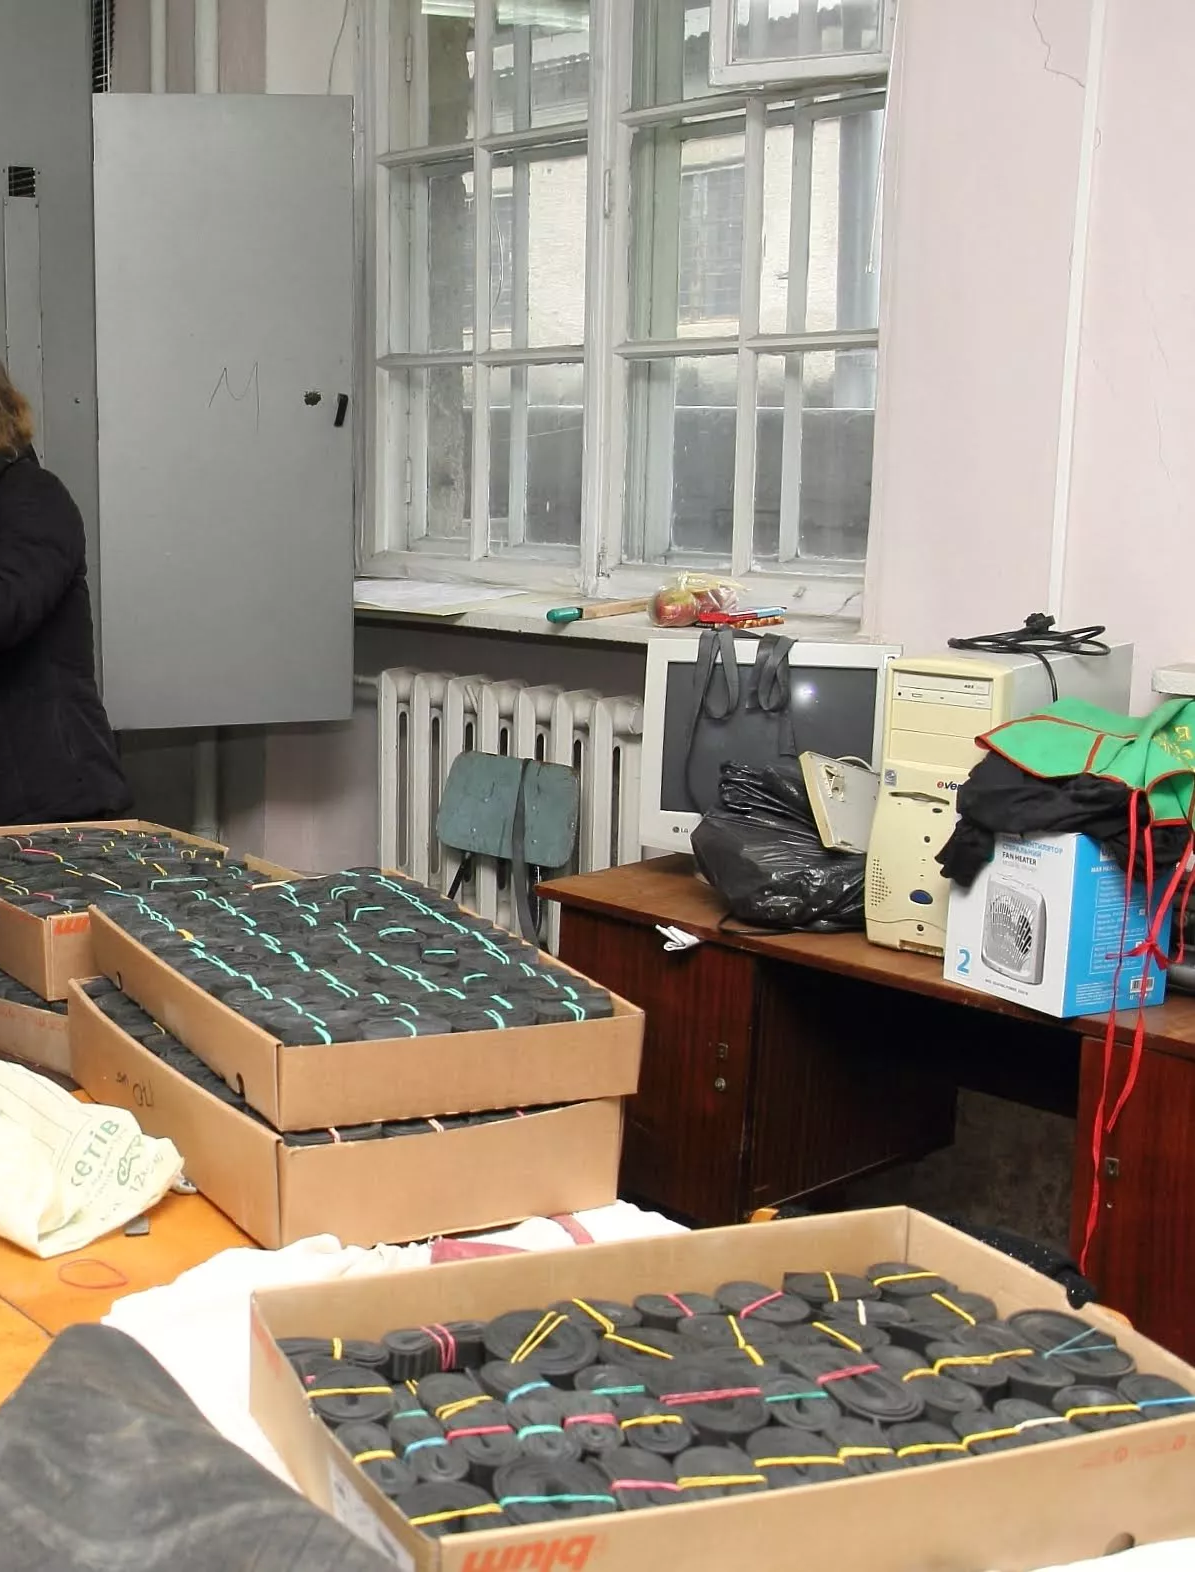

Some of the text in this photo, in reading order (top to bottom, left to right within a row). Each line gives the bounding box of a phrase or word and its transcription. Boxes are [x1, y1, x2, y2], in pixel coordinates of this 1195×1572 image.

[1002, 851, 1037, 866] FAN HEATER
[956, 948, 972, 974] 2
[461, 1535, 596, 1572] blum
